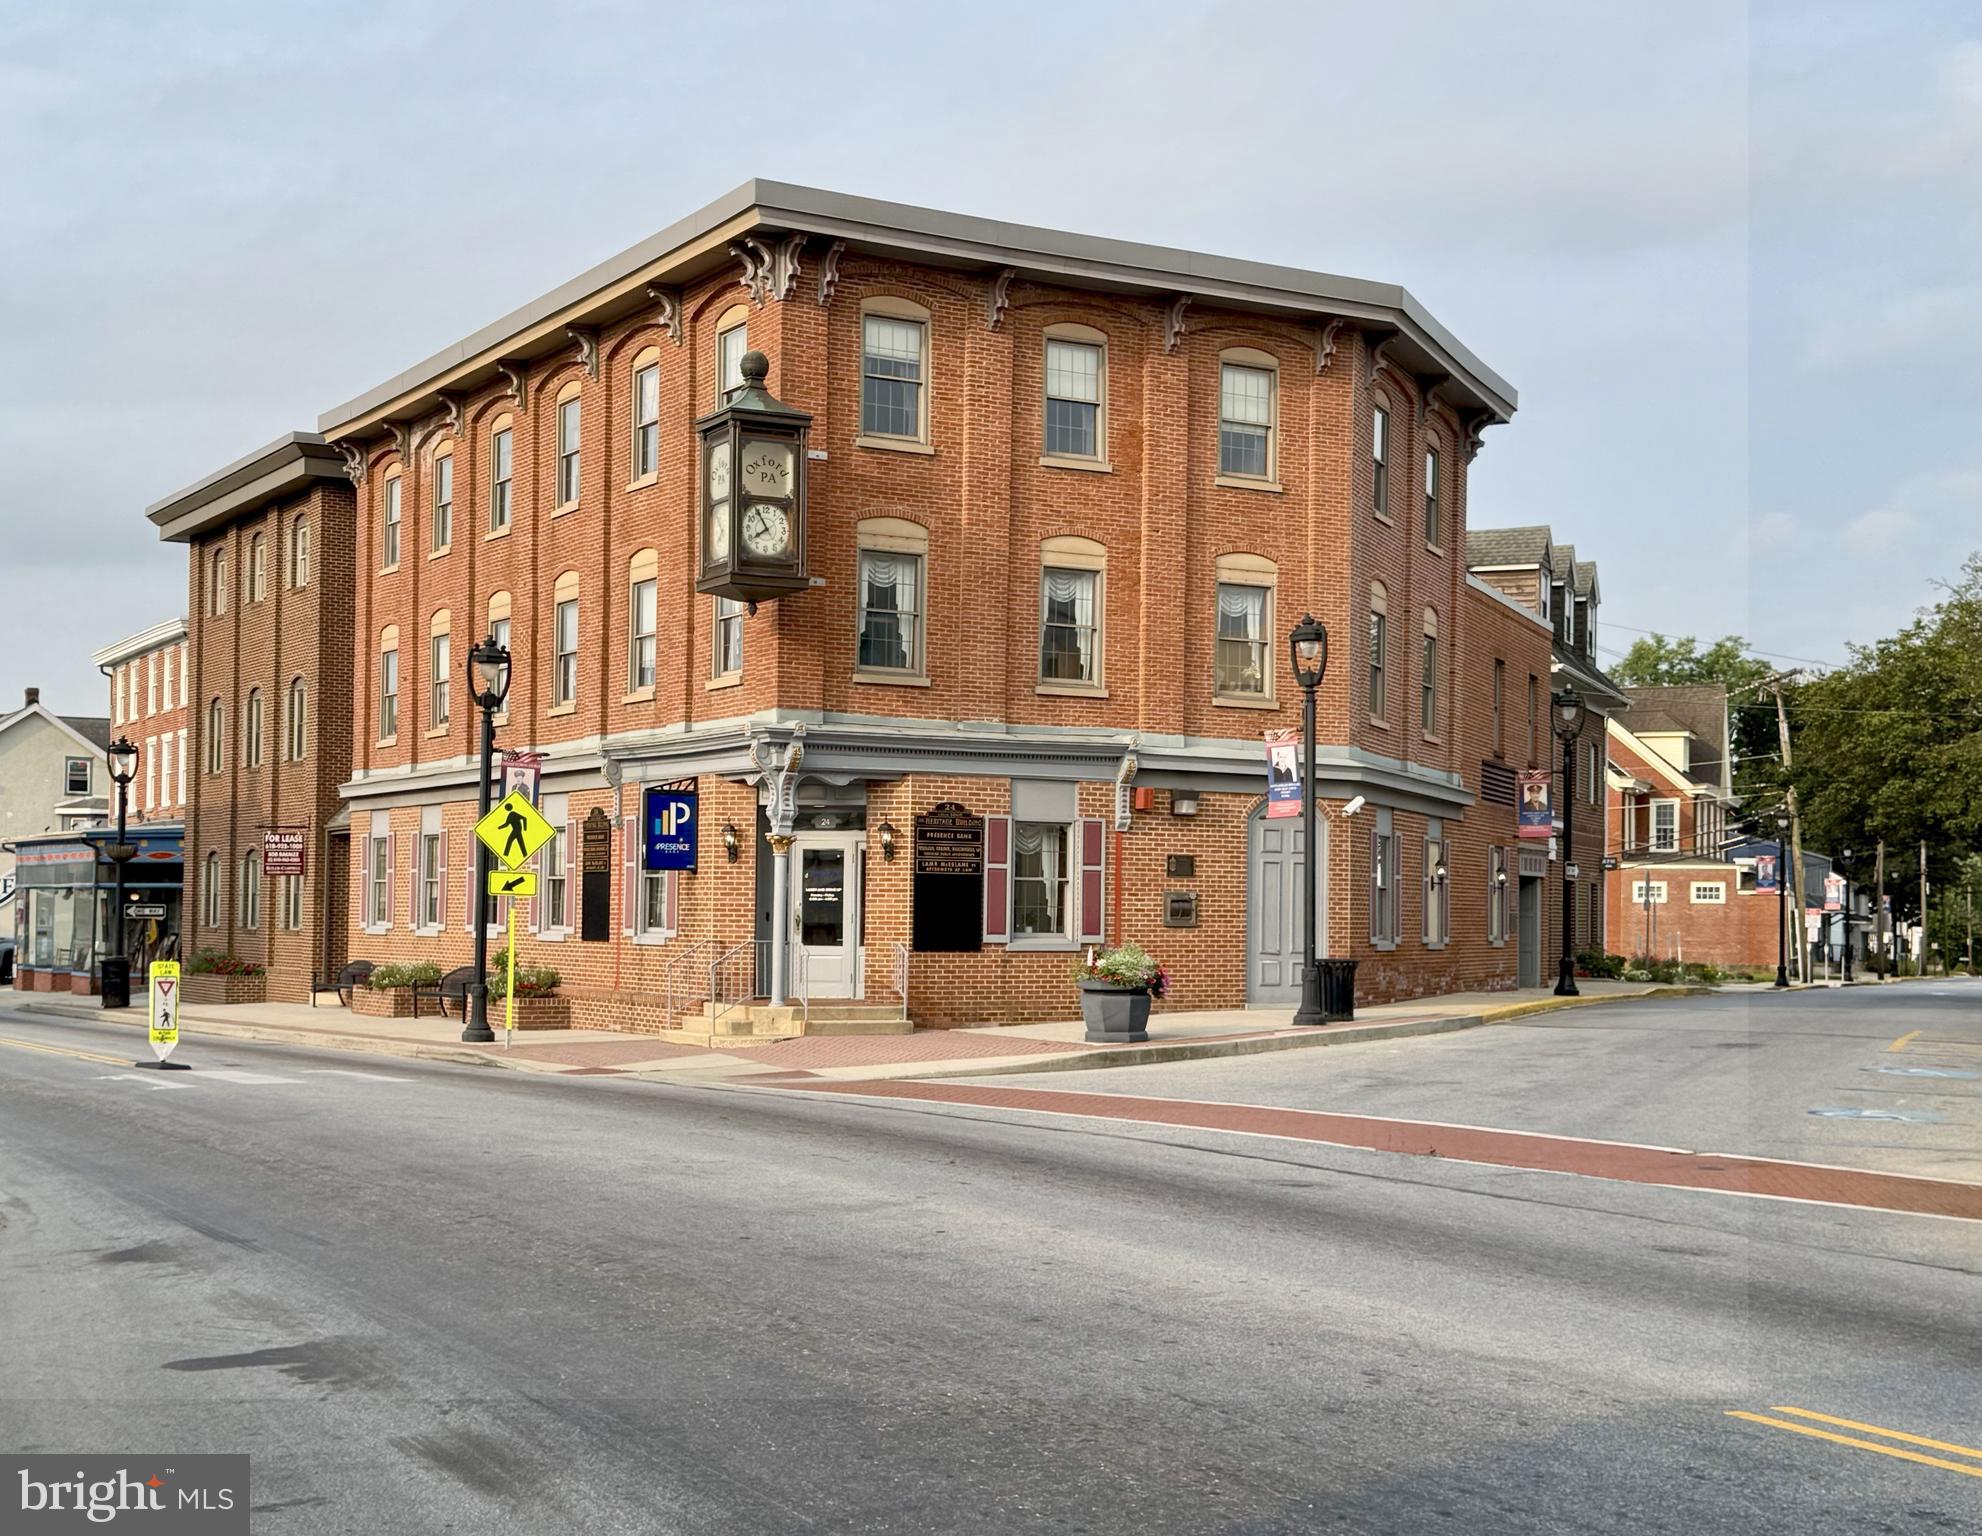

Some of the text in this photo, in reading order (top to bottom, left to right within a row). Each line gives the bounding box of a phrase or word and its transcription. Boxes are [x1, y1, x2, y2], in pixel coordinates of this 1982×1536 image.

[745, 454, 790, 478] Oxford
[760, 472, 776, 484] PA
[762, 506, 770, 514] 12
[779, 517, 784, 525] 2
[780, 527, 786, 536] 3
[265, 834, 303, 842] FOR LEASE
